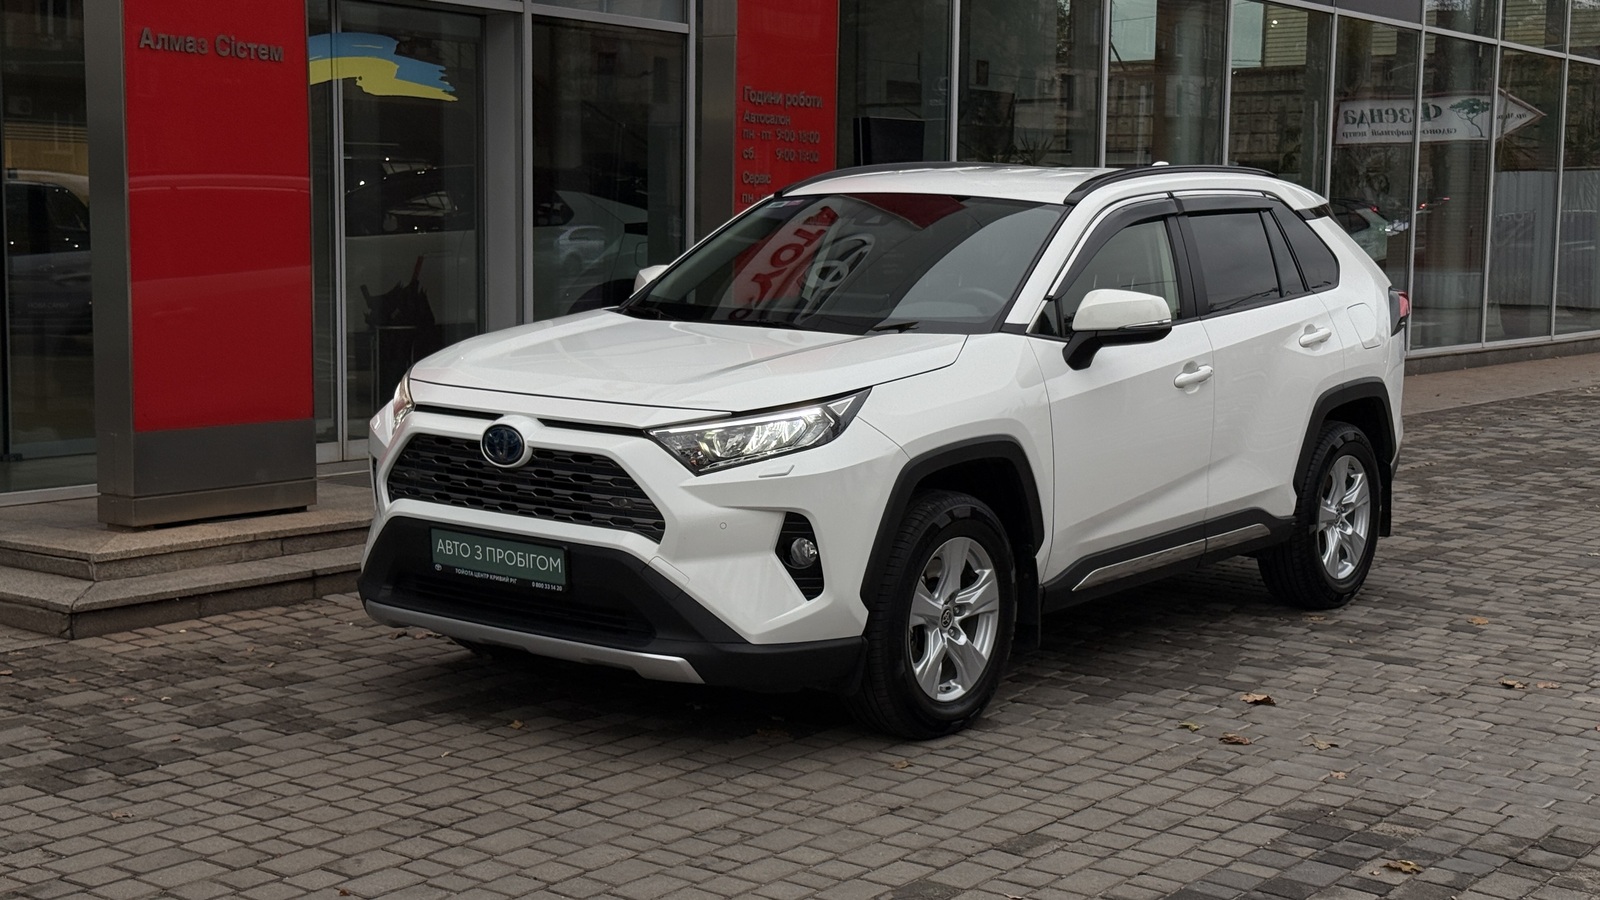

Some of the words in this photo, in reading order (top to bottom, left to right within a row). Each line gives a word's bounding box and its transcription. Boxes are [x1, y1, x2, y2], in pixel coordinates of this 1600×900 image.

[139, 26, 208, 54] Алмаз
[215, 34, 285, 62] Сістем
[743, 86, 782, 105] Години
[785, 91, 823, 109] роботи
[743, 110, 791, 126] Автосалон
[436, 538, 471, 558] АВТО
[486, 546, 562, 573] ПРОБІГОМ
